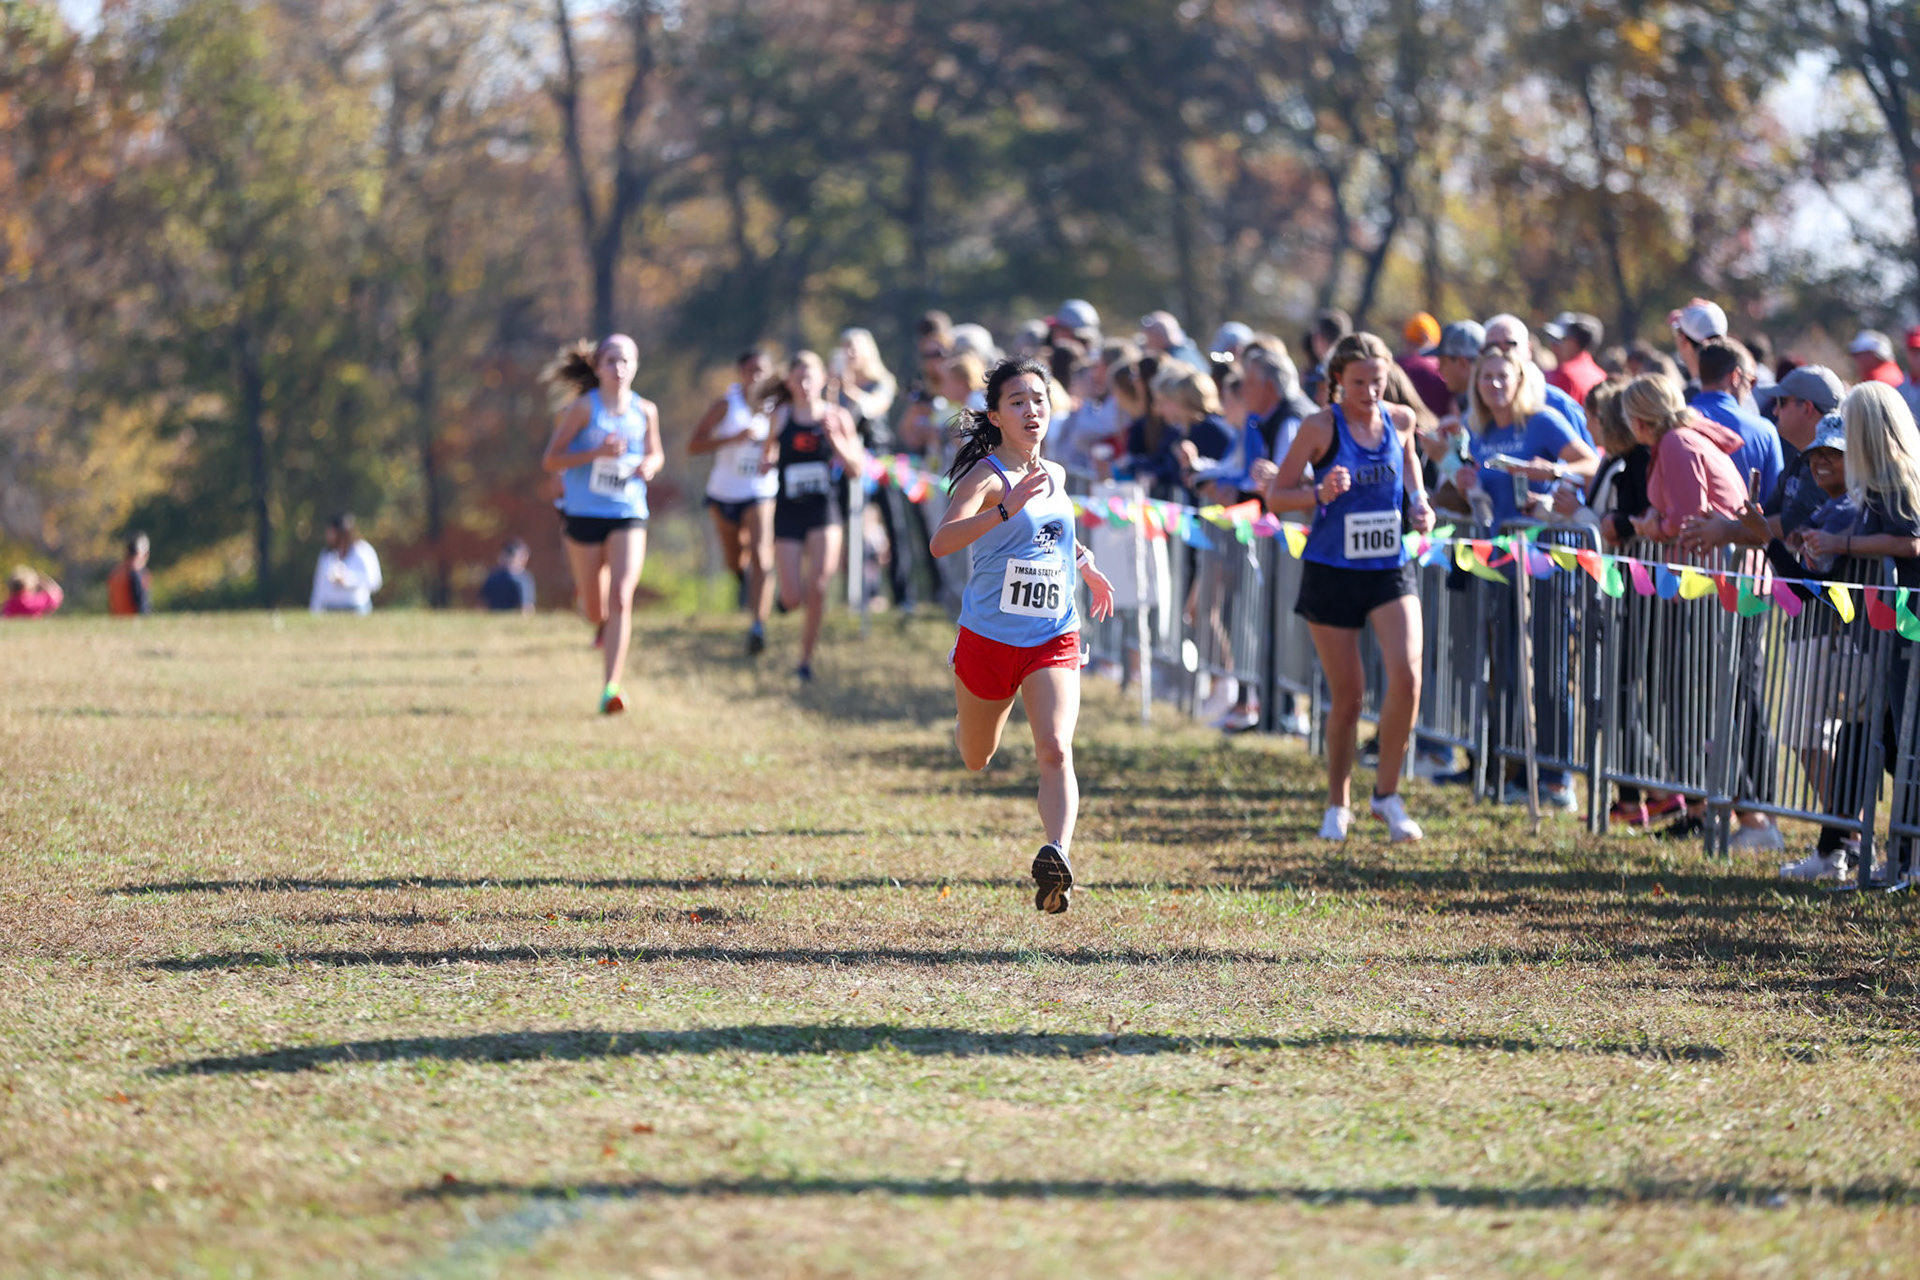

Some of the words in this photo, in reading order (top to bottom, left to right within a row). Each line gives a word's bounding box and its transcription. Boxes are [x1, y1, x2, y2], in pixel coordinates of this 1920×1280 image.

[1356, 463, 1397, 485] GPS
[1351, 528, 1395, 552] 1106
[1014, 565, 1037, 577] TMSAA
[1037, 568, 1054, 578] STATE
[1009, 580, 1061, 610] 1196
